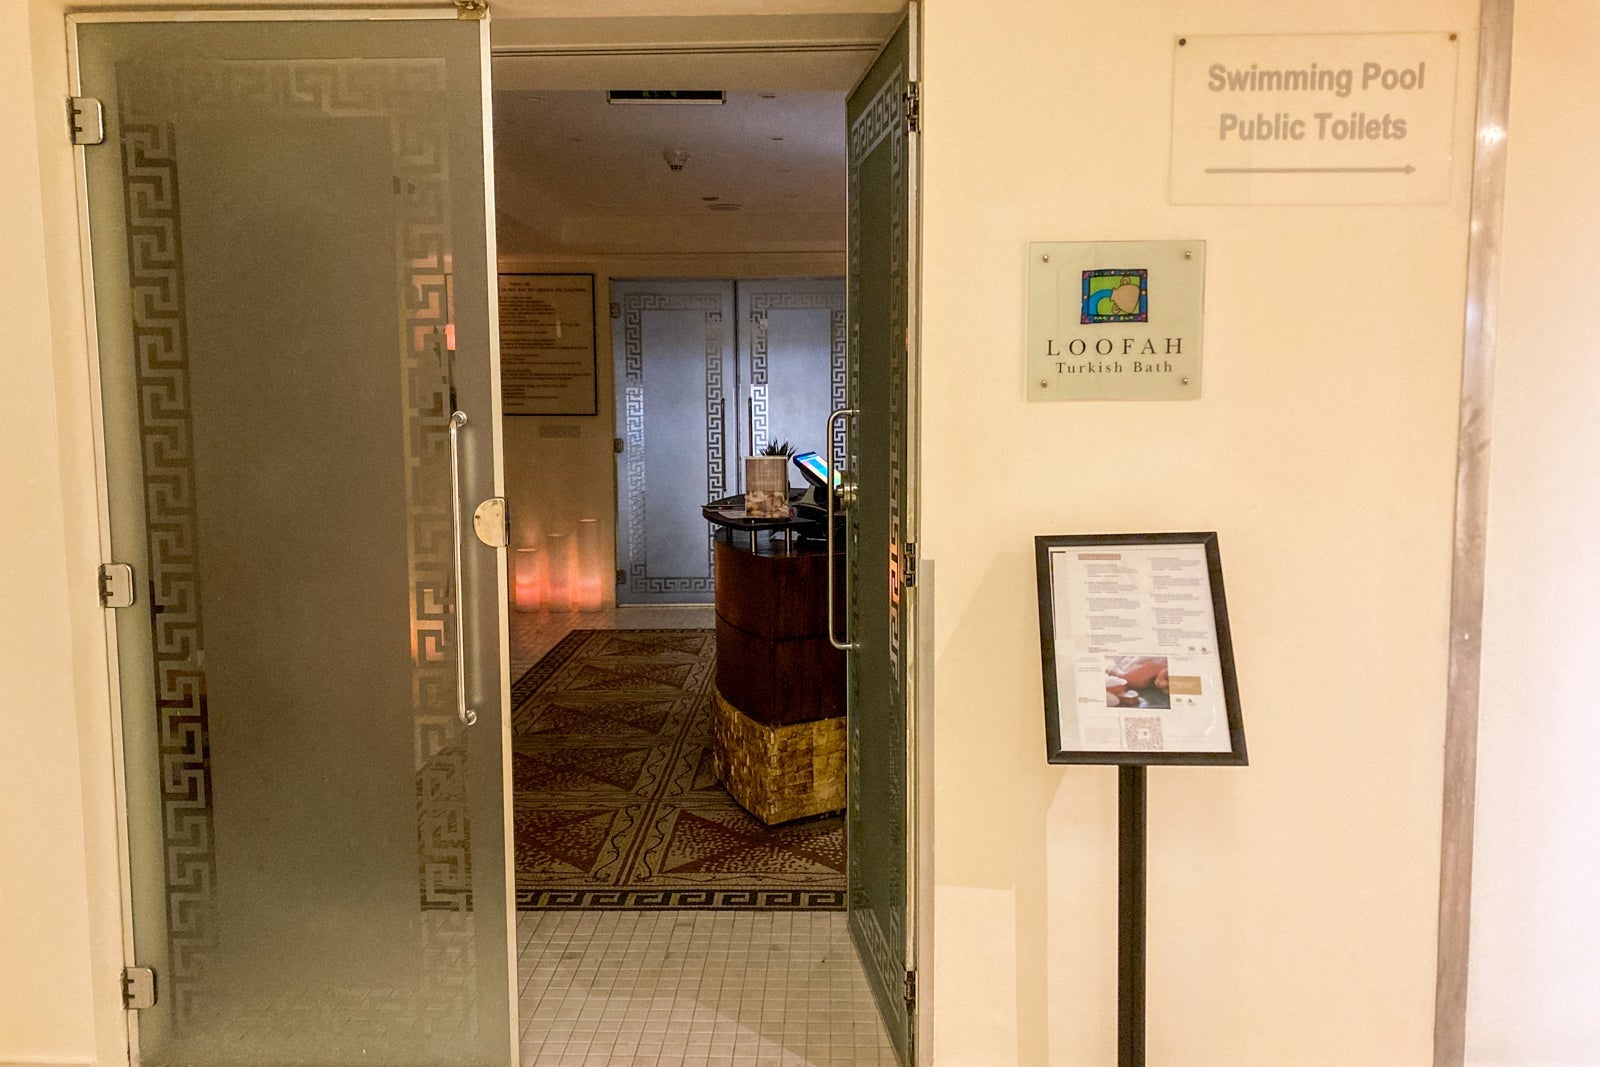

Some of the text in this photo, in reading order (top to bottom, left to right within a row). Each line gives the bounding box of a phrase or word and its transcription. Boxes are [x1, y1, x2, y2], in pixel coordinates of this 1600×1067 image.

[1208, 62, 1425, 97] Swimming Pool
[1219, 112, 1407, 140] Public Toilets
[1046, 338, 1182, 356] LOOFAH
[1056, 361, 1173, 374] Turkish Bath
